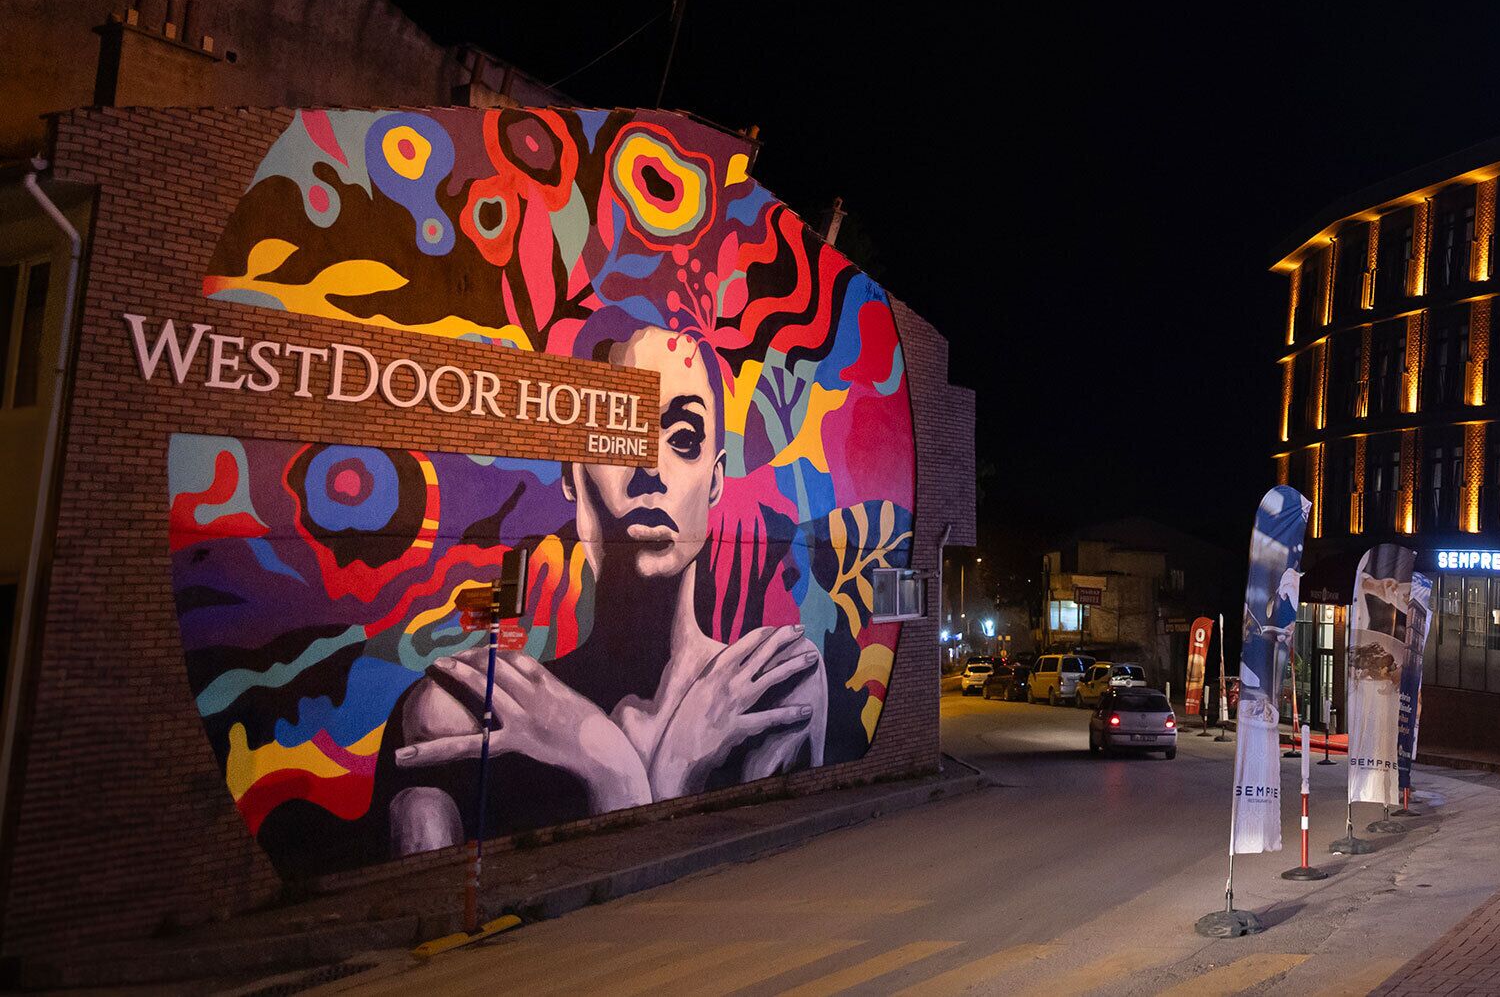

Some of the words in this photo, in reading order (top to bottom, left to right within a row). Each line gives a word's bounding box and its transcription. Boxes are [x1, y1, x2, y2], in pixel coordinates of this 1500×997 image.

[516, 378, 648, 433] HOTEL
[1350, 758, 1398, 771] SEMPRE
[1235, 785, 1278, 799] SEMPRE
